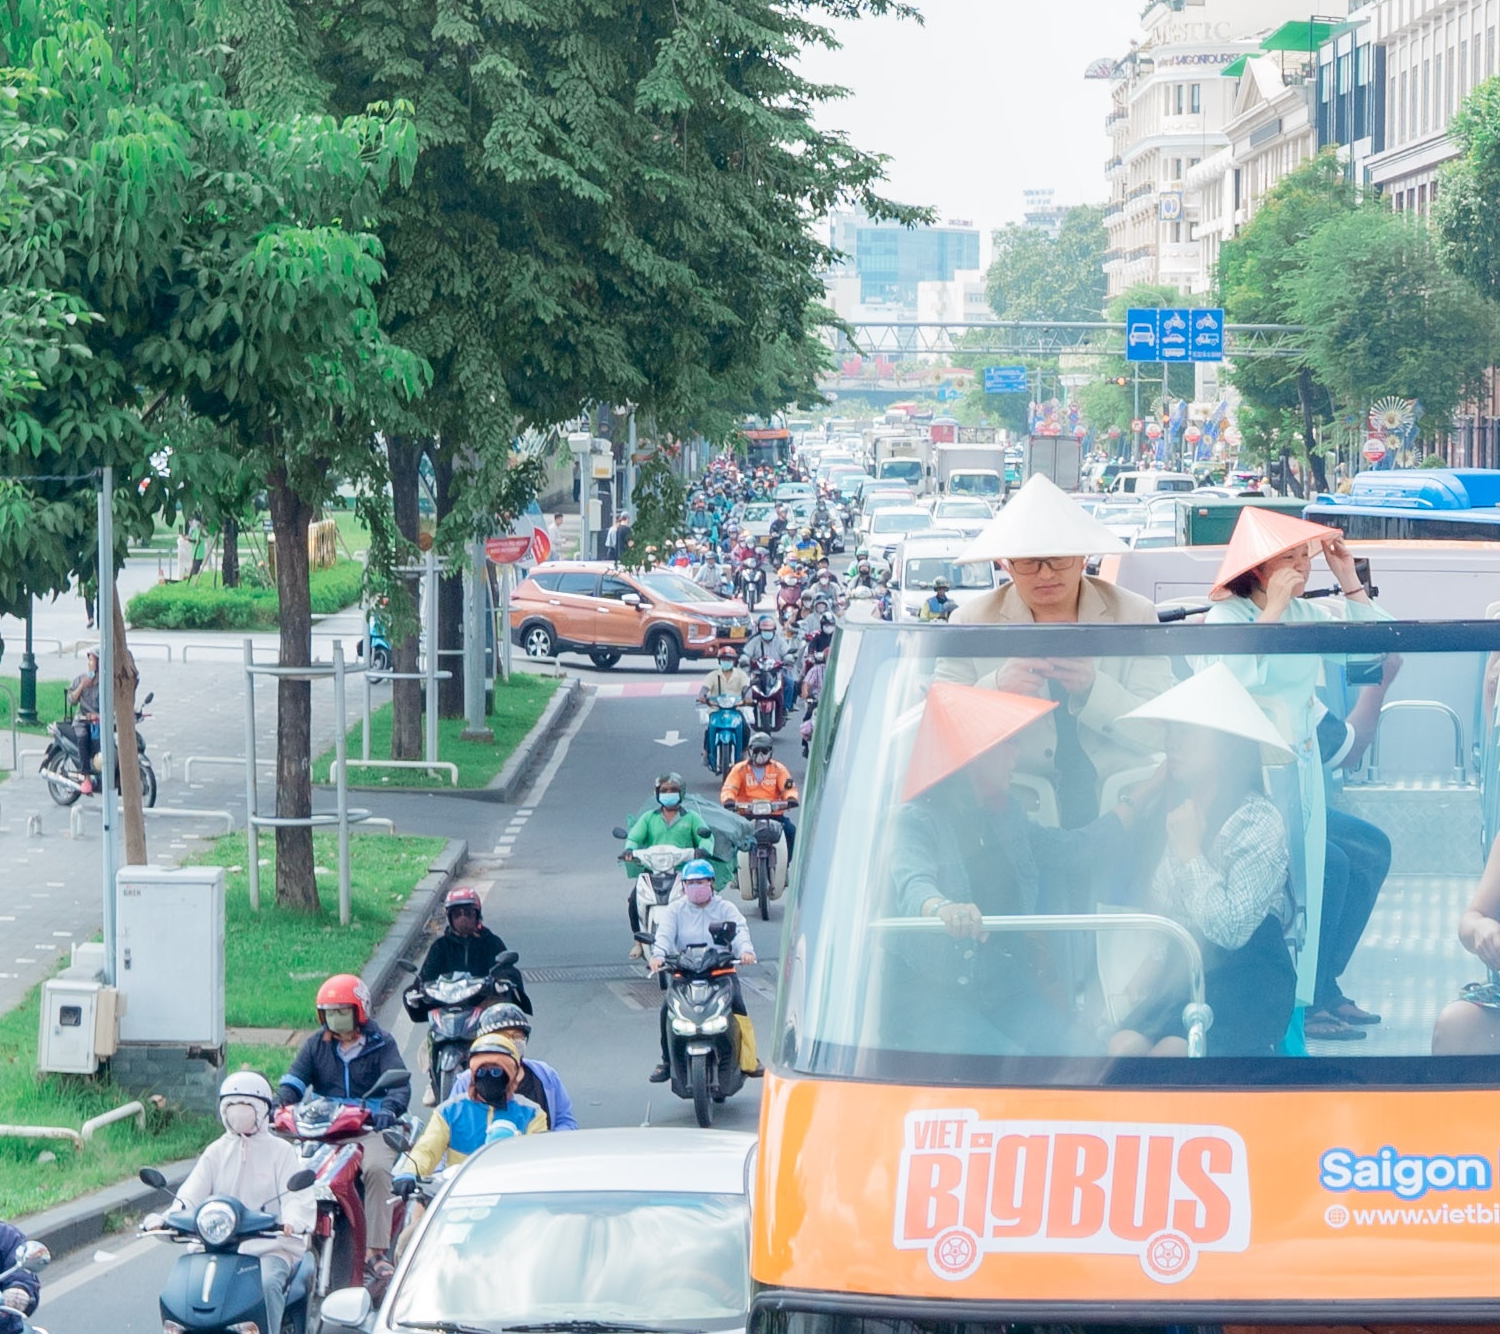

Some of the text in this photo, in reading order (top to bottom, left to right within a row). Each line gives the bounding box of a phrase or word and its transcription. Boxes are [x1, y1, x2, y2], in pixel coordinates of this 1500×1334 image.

[914, 1119, 968, 1150] VIET
[903, 1132, 1234, 1244] BigBUS
[1321, 1147, 1488, 1198] Saigon
